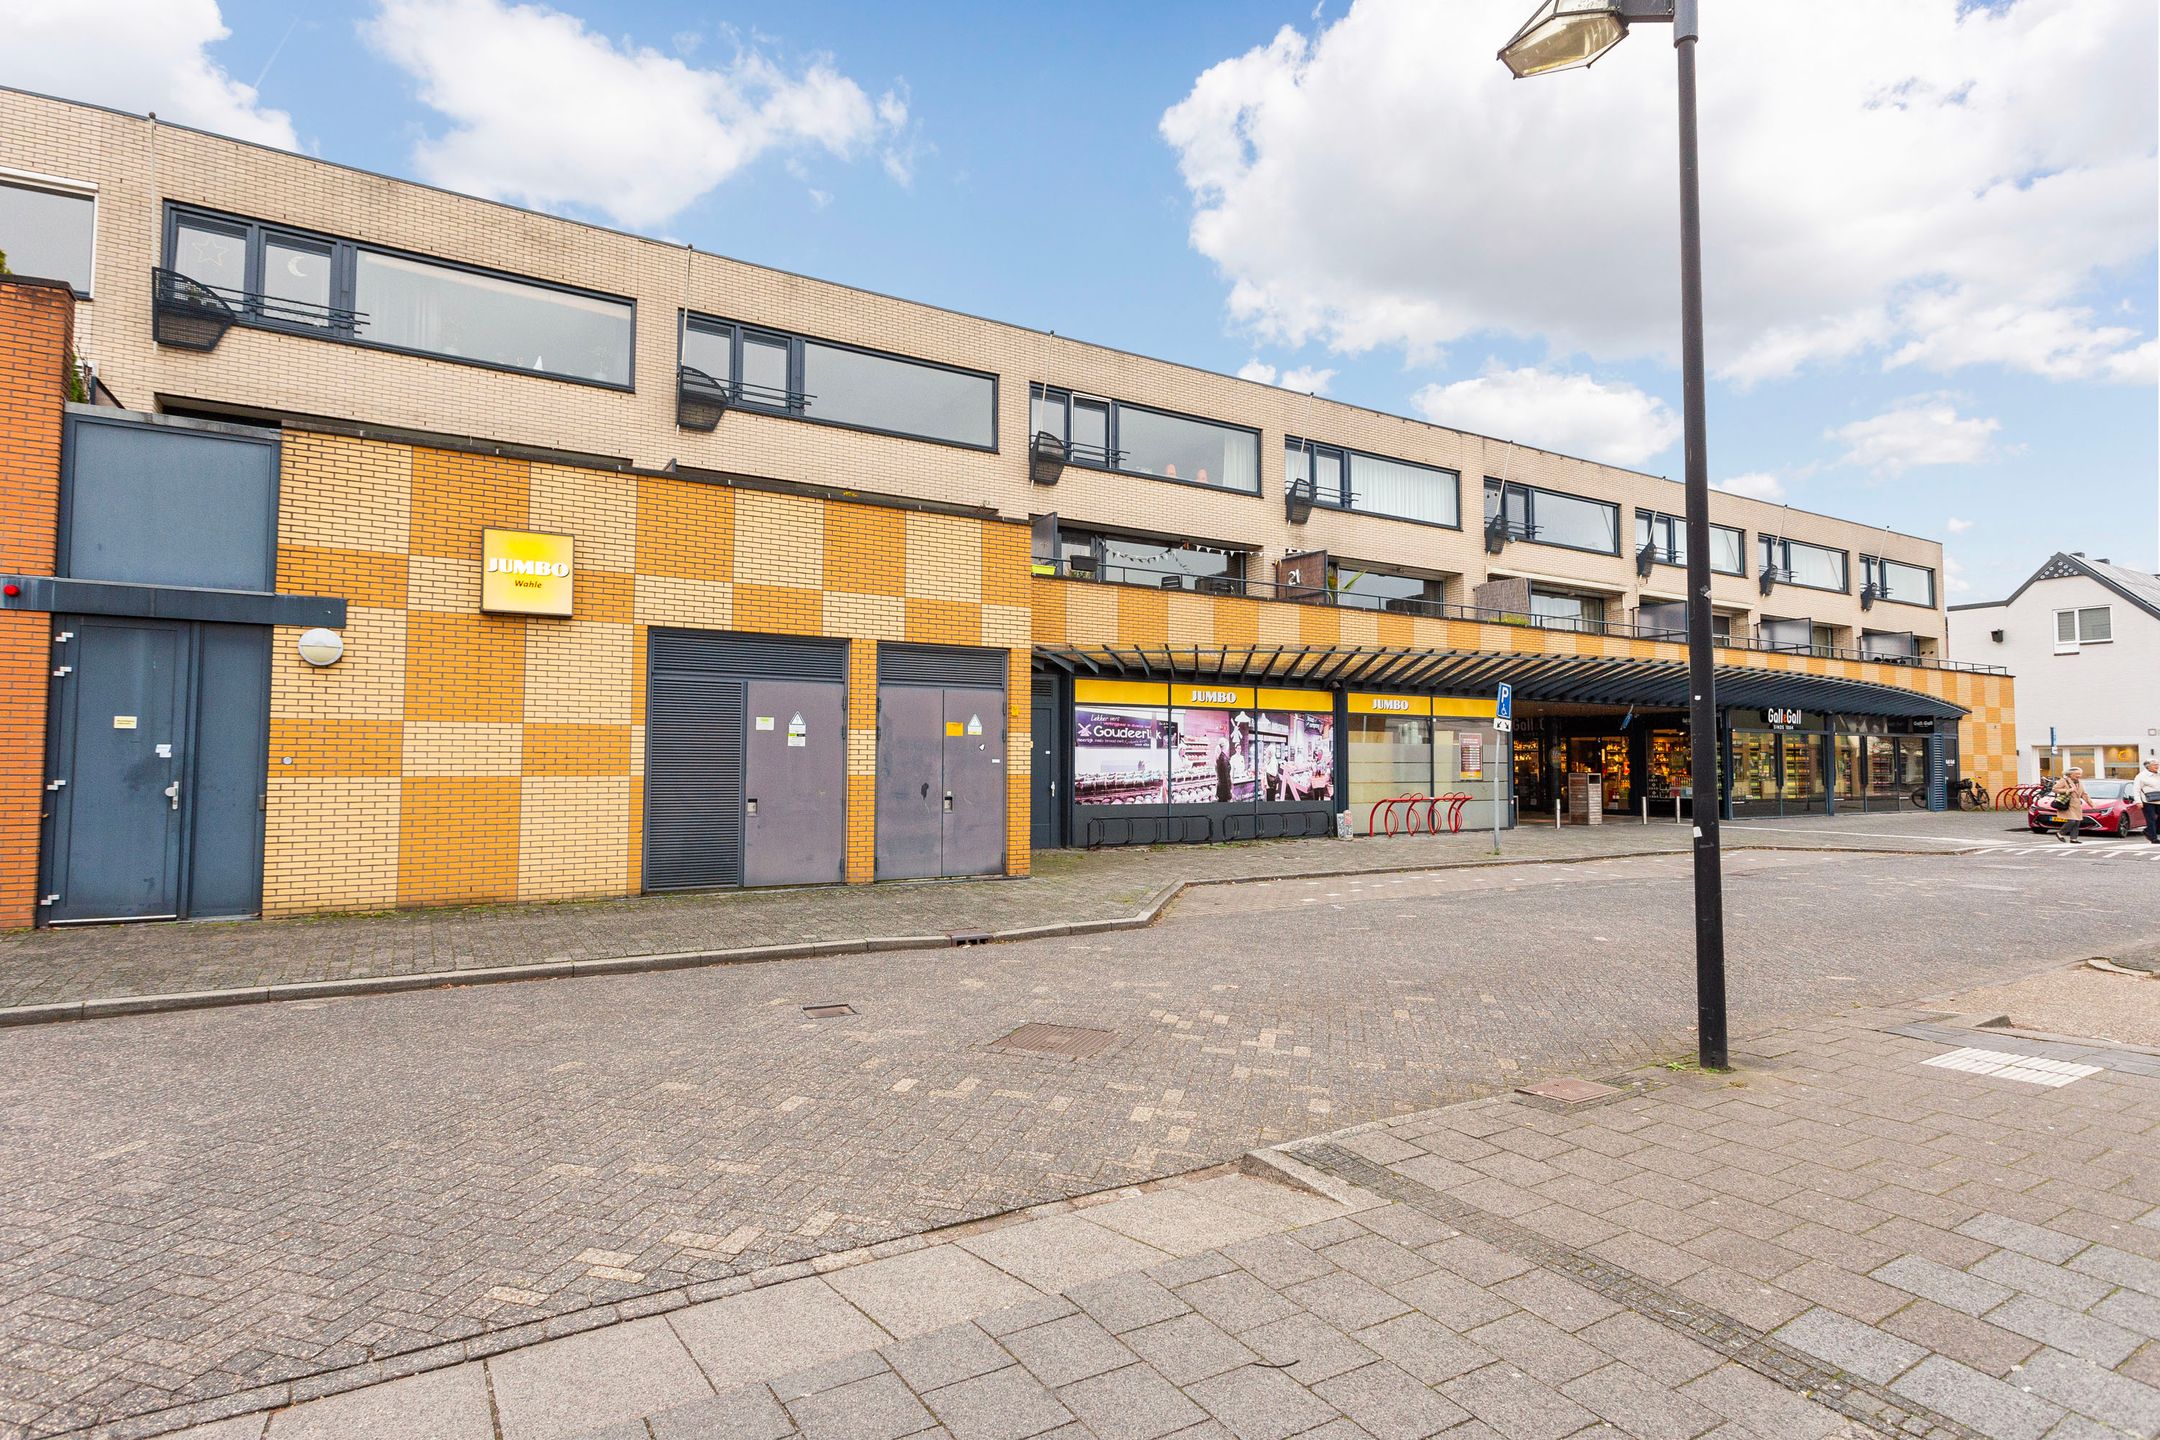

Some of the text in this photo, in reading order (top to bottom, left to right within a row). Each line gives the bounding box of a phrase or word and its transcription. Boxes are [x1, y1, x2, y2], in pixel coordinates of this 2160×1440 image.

[487, 557, 570, 578] JUMBO
[514, 579, 542, 589] Wahle
[1191, 690, 1237, 704] JUMBO
[1501, 686, 1509, 704] P
[1372, 698, 1409, 711] JUMBO
